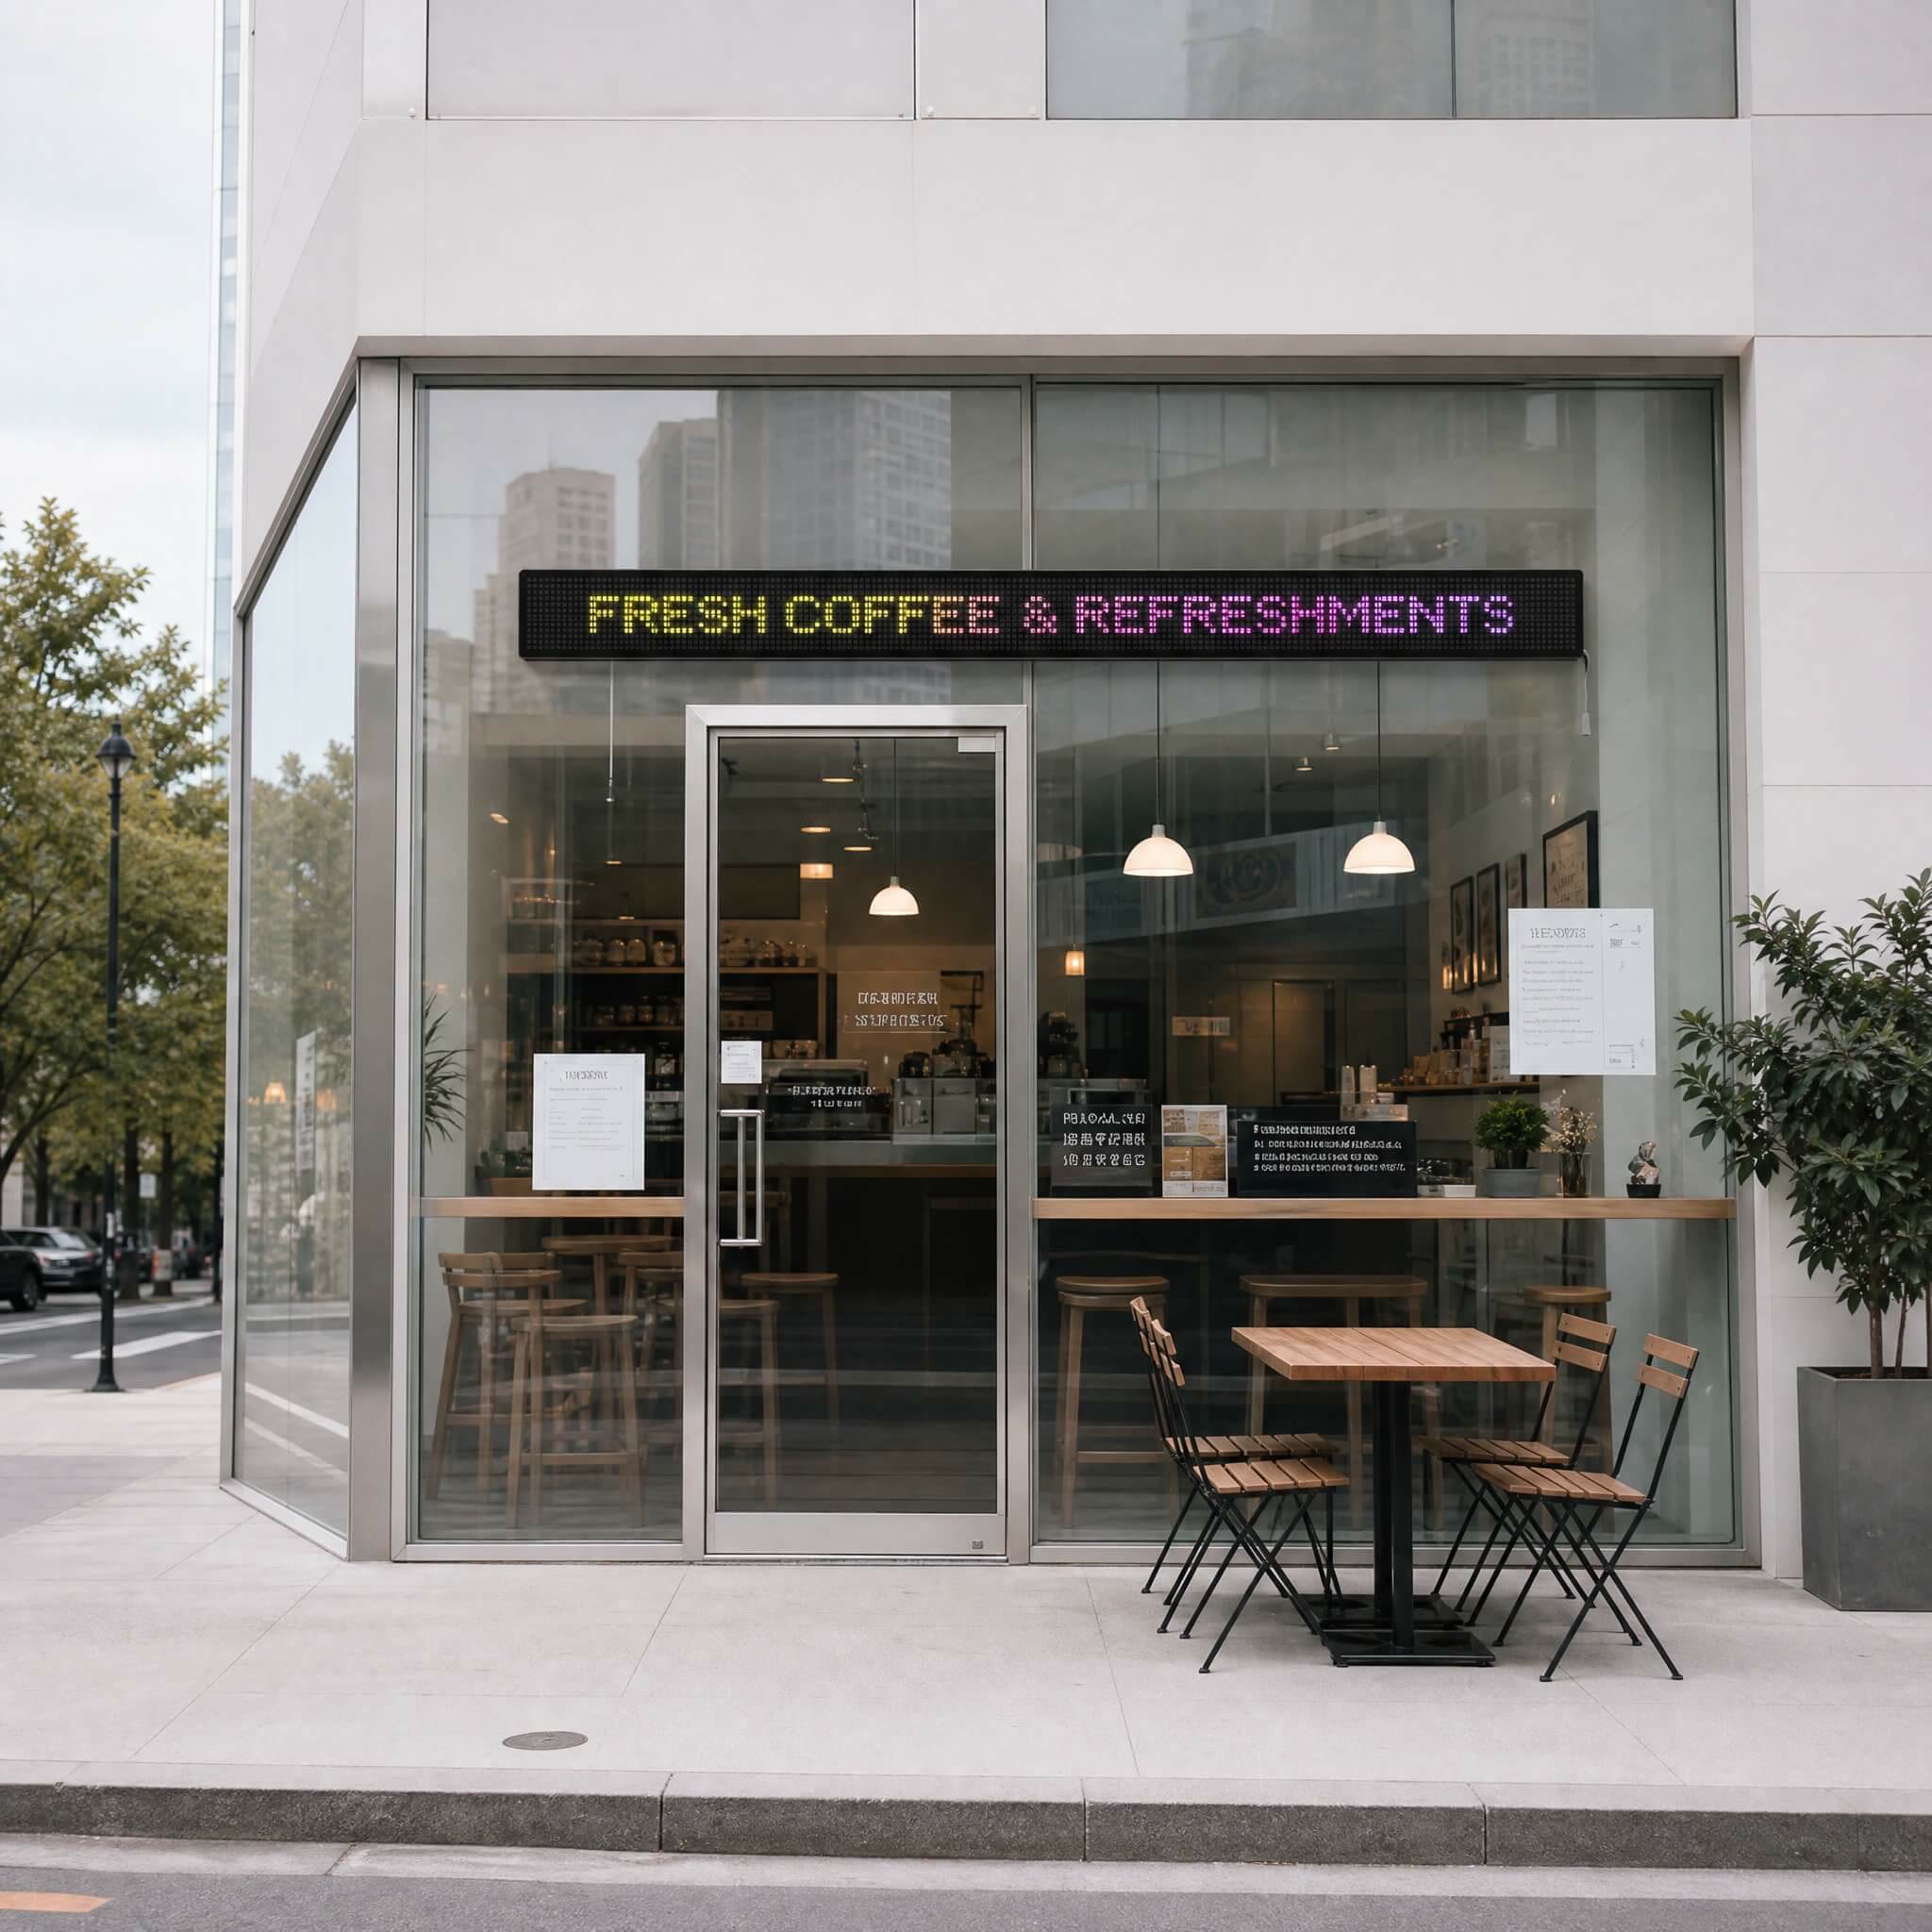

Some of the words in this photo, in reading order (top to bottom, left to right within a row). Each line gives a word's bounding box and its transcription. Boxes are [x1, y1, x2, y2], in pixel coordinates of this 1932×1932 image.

[589, 595, 766, 634] FRESH
[785, 595, 1000, 634] COFFEE
[1024, 595, 1058, 634] &
[1074, 595, 1514, 634] REFRESHMENTS
